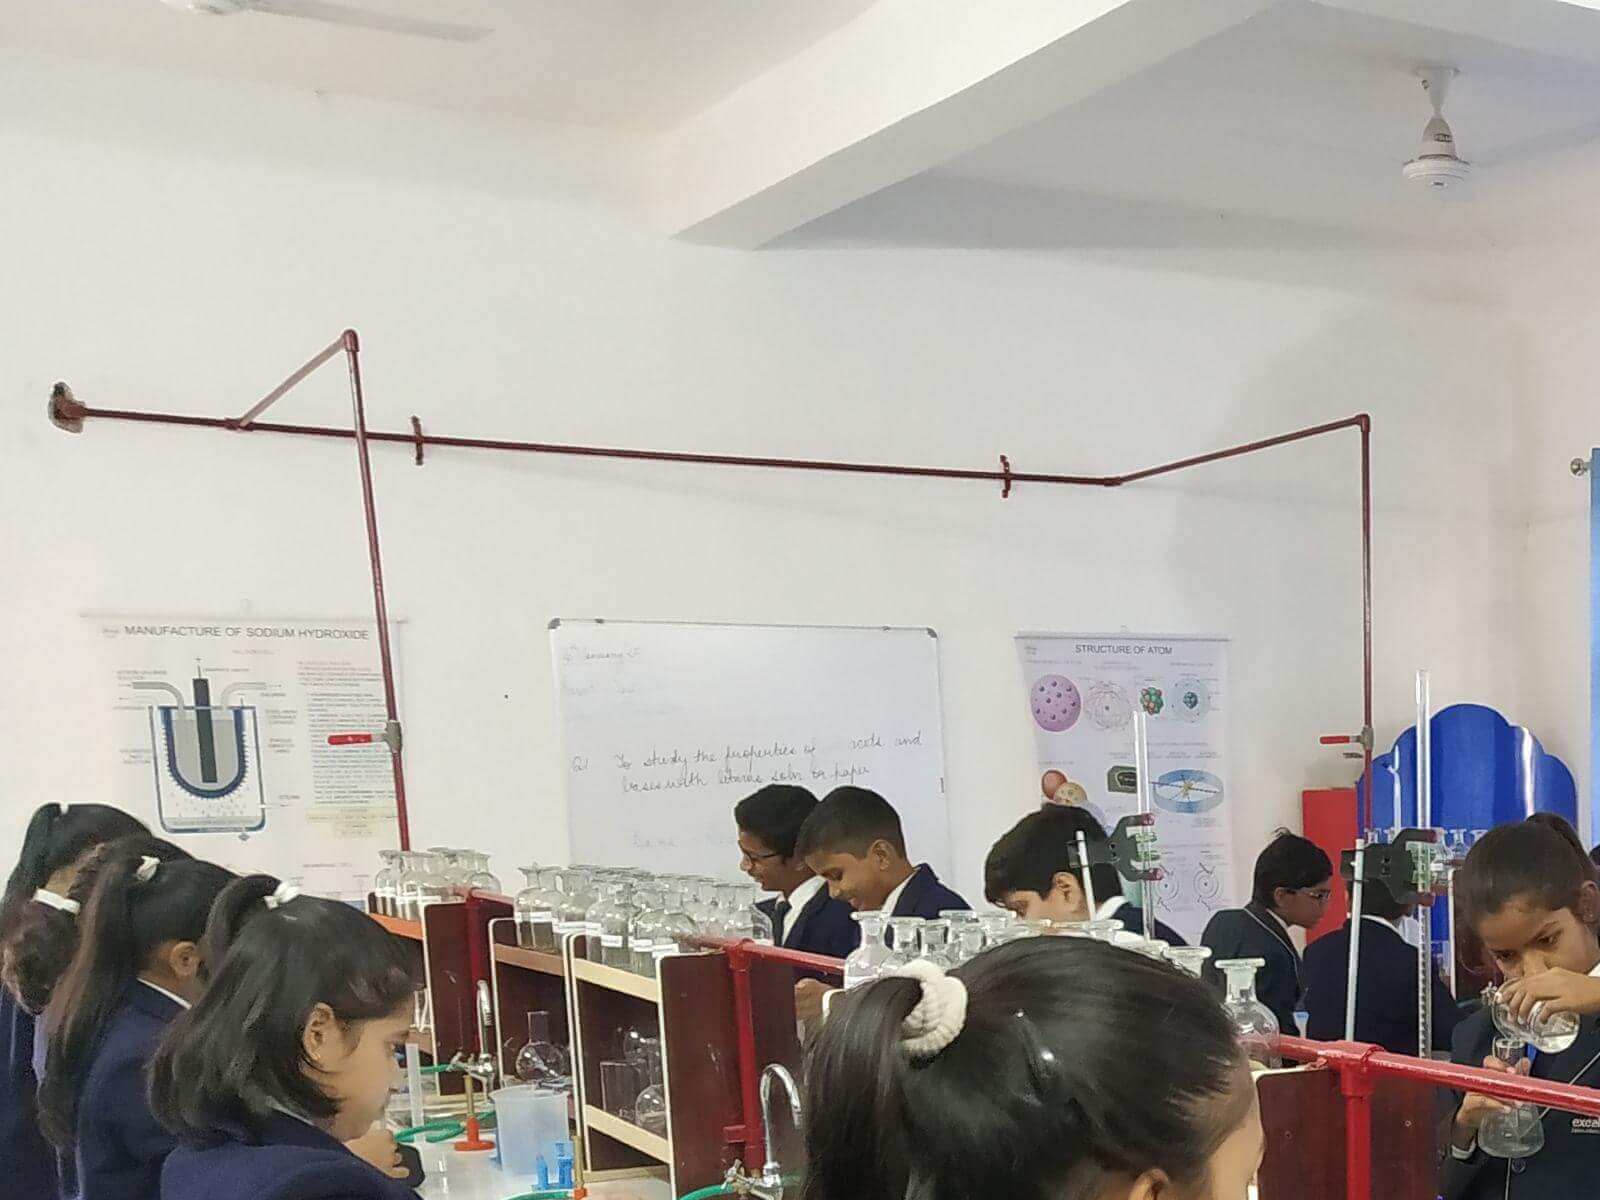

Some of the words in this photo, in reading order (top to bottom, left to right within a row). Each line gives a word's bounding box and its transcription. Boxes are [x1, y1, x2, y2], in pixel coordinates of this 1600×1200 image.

[124, 625, 221, 637] MANUFACTURE
[225, 626, 241, 637] OF
[246, 627, 295, 638] SODIUM
[299, 629, 369, 640] HYDROXIDE
[1075, 644, 1132, 654] STRUCTURE
[1133, 645, 1145, 654] OF
[1148, 646, 1172, 655] ATOM
[694, 749, 716, 763] the
